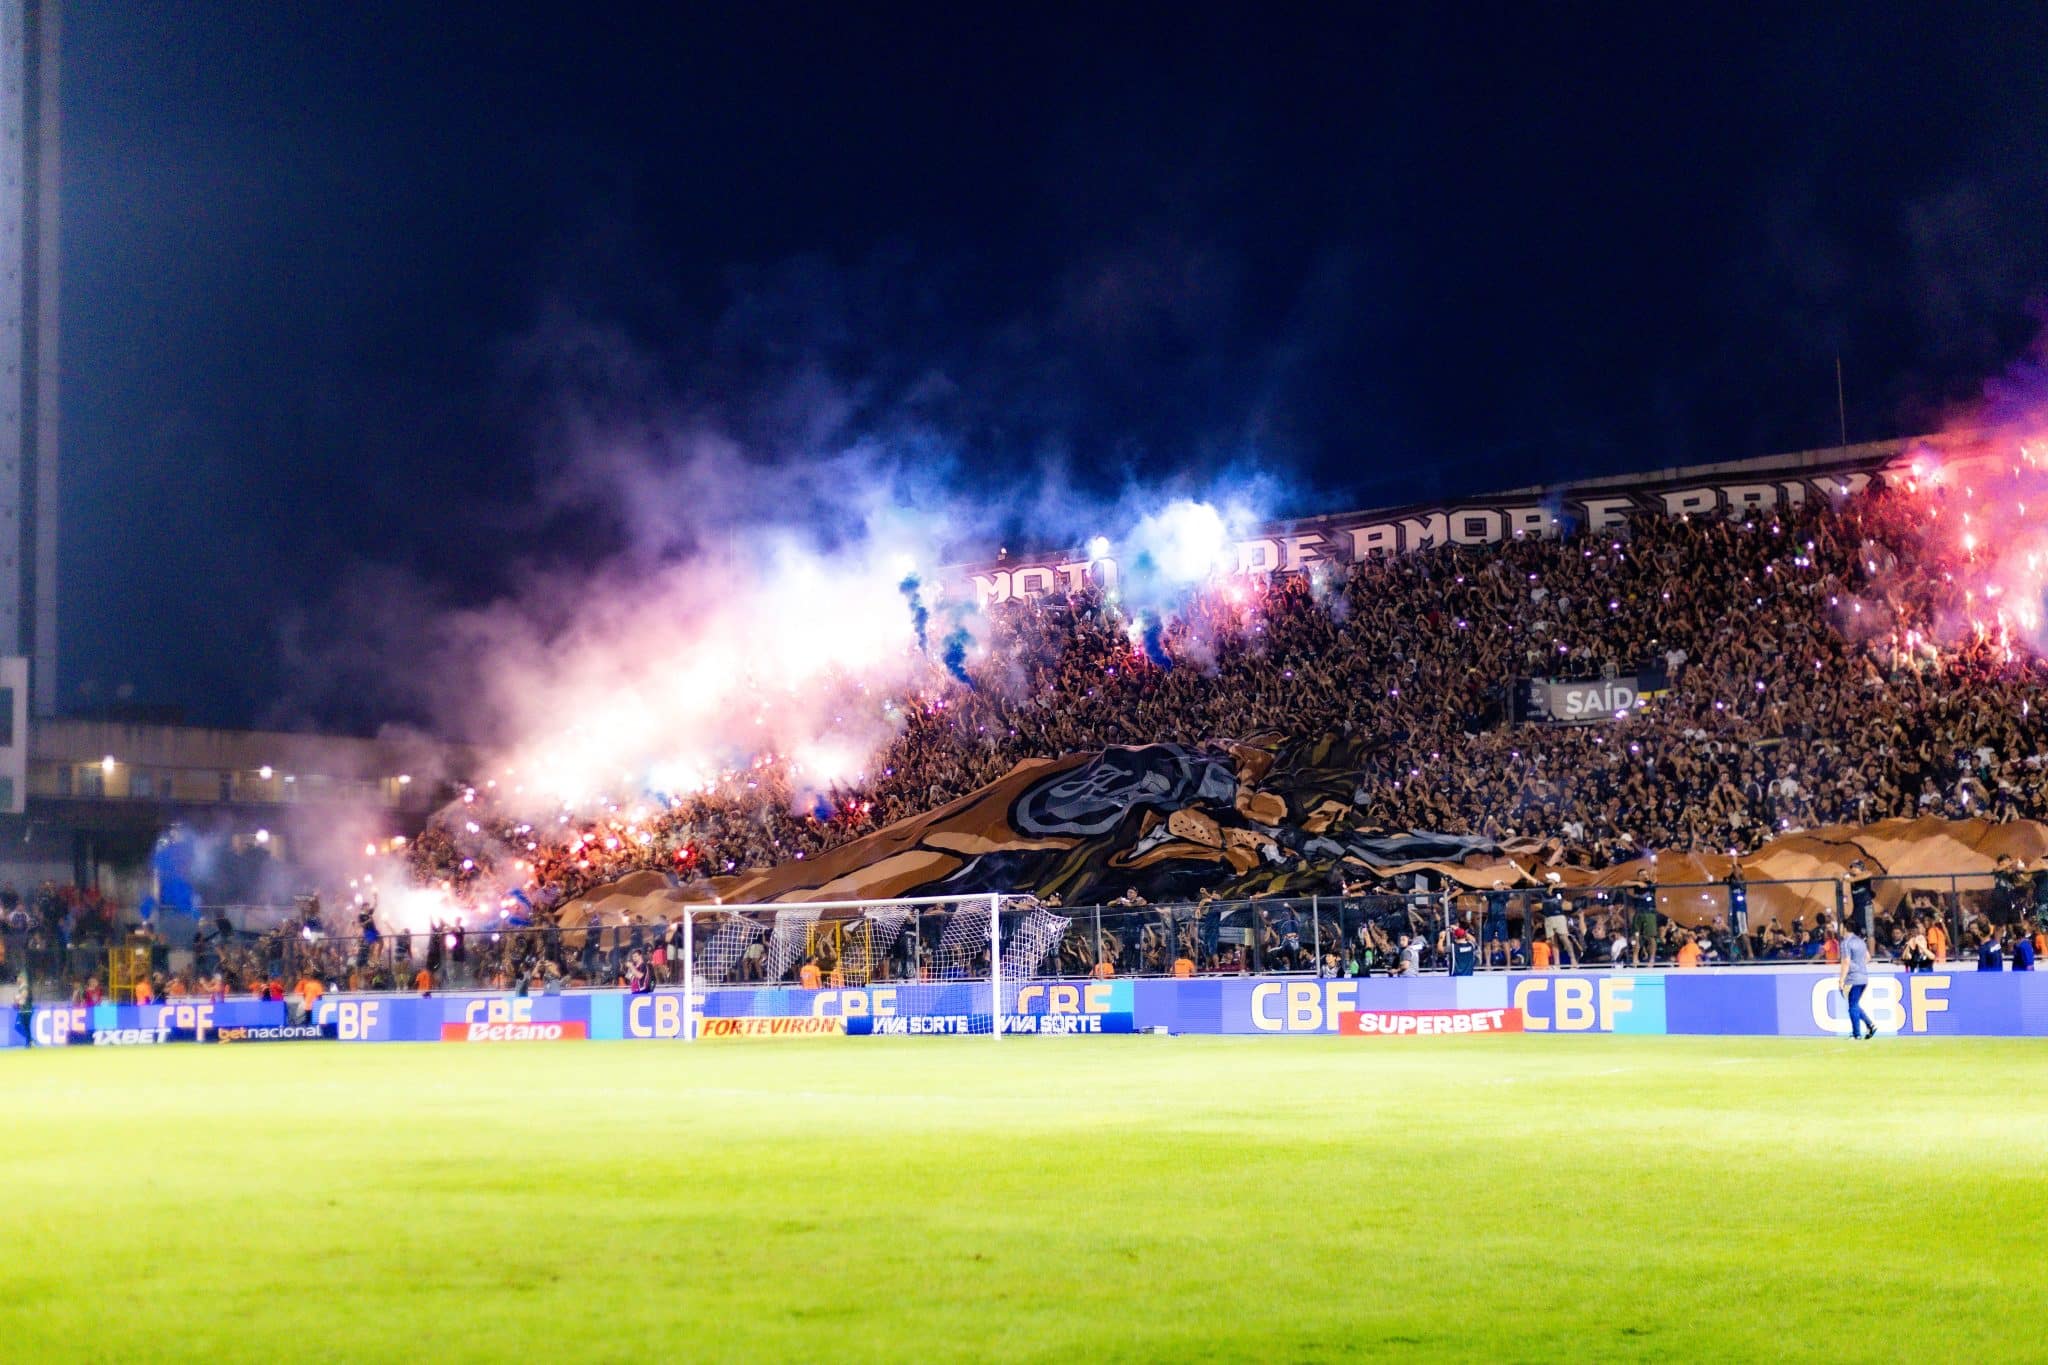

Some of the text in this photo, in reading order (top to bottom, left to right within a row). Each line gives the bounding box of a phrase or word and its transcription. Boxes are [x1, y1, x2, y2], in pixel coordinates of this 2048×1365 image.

[1233, 532, 1325, 577] DE
[1350, 507, 1557, 563] AMOR
[1579, 497, 1634, 534] E
[1251, 981, 1358, 1031] CBF
[1514, 978, 1635, 1030] CBF
[1812, 975, 1952, 1033] CBF
[36, 1009, 87, 1044] CBF
[318, 1001, 379, 1040] CBF
[467, 1023, 563, 1040] Betano
[703, 1017, 837, 1036] FORTEVIRON
[909, 1015, 968, 1033] SORTE
[1040, 1015, 1102, 1033] SORTE
[1358, 1010, 1505, 1034] SUPERBET
[92, 1028, 171, 1045] 1XBET
[218, 1024, 322, 1042] betnacional
